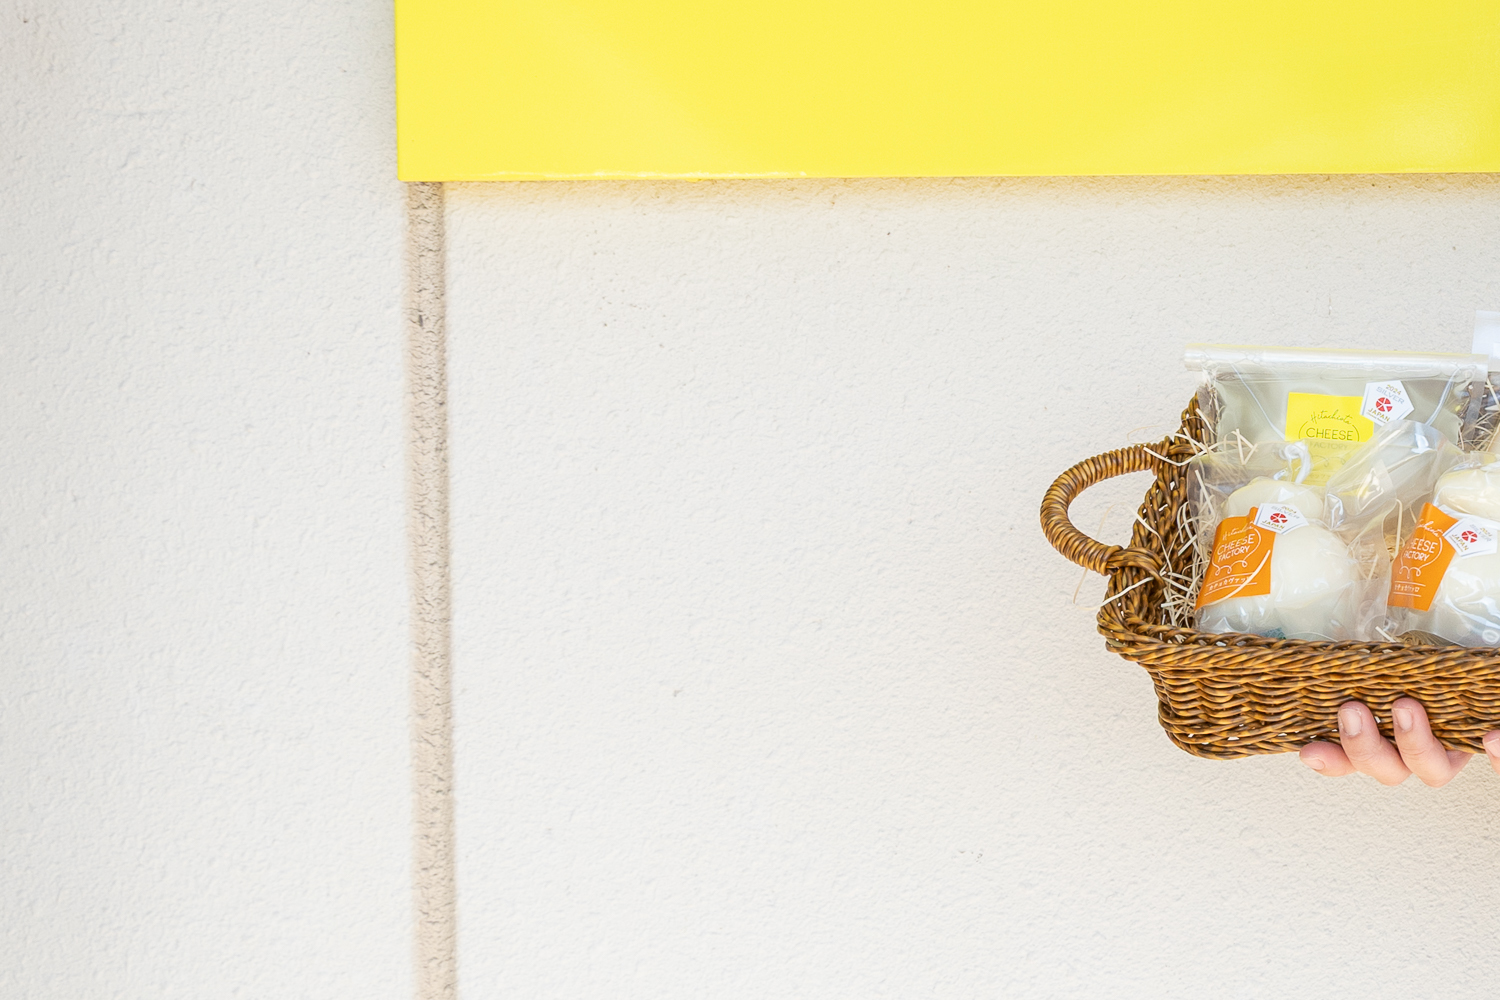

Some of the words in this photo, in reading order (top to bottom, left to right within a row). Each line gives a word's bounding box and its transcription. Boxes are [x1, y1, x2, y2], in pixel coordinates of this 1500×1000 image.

[1376, 386, 1405, 405] SILVER
[1386, 384, 1402, 395] 2024
[1368, 408, 1390, 422] JAPAN
[1306, 427, 1353, 441] CHEESE
[1310, 441, 1348, 450] FACTORY
[1262, 520, 1285, 530] JAPAN
[1217, 533, 1255, 555] CHEESE
[1218, 545, 1250, 563] FACTORY
